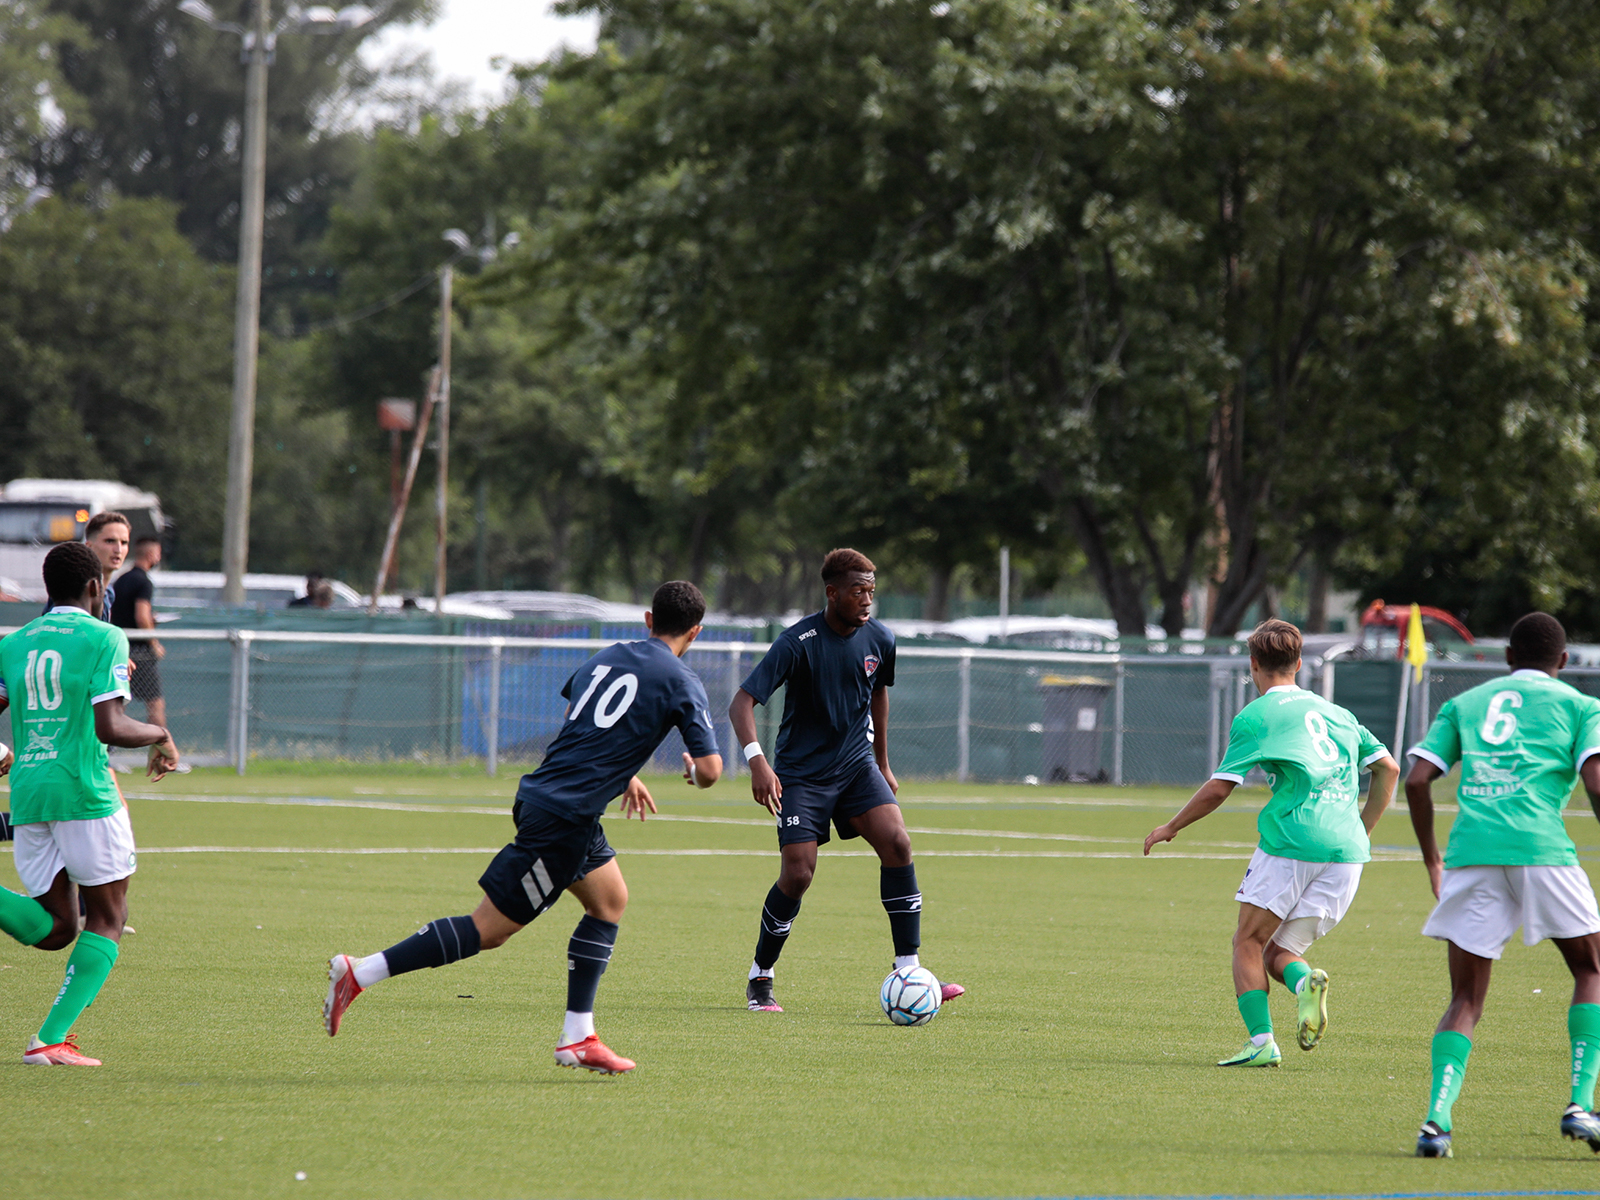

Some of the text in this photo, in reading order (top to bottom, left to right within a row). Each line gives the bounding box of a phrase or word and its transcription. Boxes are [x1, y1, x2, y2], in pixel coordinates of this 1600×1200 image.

[24, 649, 63, 711] 10
[569, 664, 639, 729] 10
[1304, 710, 1339, 762] 8
[1481, 690, 1523, 745] 6
[786, 815, 800, 827] 58
[53, 964, 75, 1006] ASSE
[1434, 1064, 1454, 1113] ASSE
